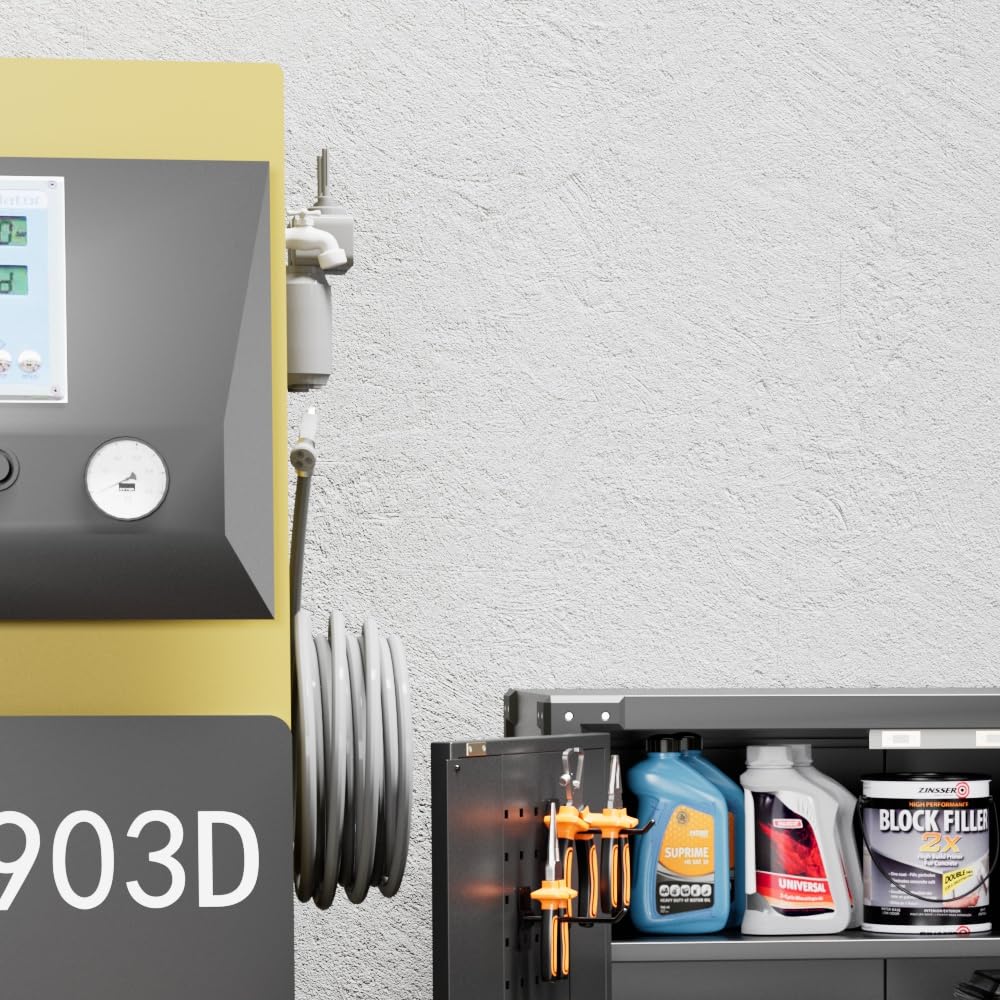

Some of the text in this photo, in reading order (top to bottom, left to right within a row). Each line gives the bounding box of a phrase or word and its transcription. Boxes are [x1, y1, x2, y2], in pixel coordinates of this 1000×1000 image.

[880, 809, 989, 832] BLOCK FILLER
[0, 809, 260, 910] 903D
[664, 847, 709, 858] SUPRIME
[945, 869, 966, 884] DOUBLE
[778, 878, 826, 893] UNIVERSAL
